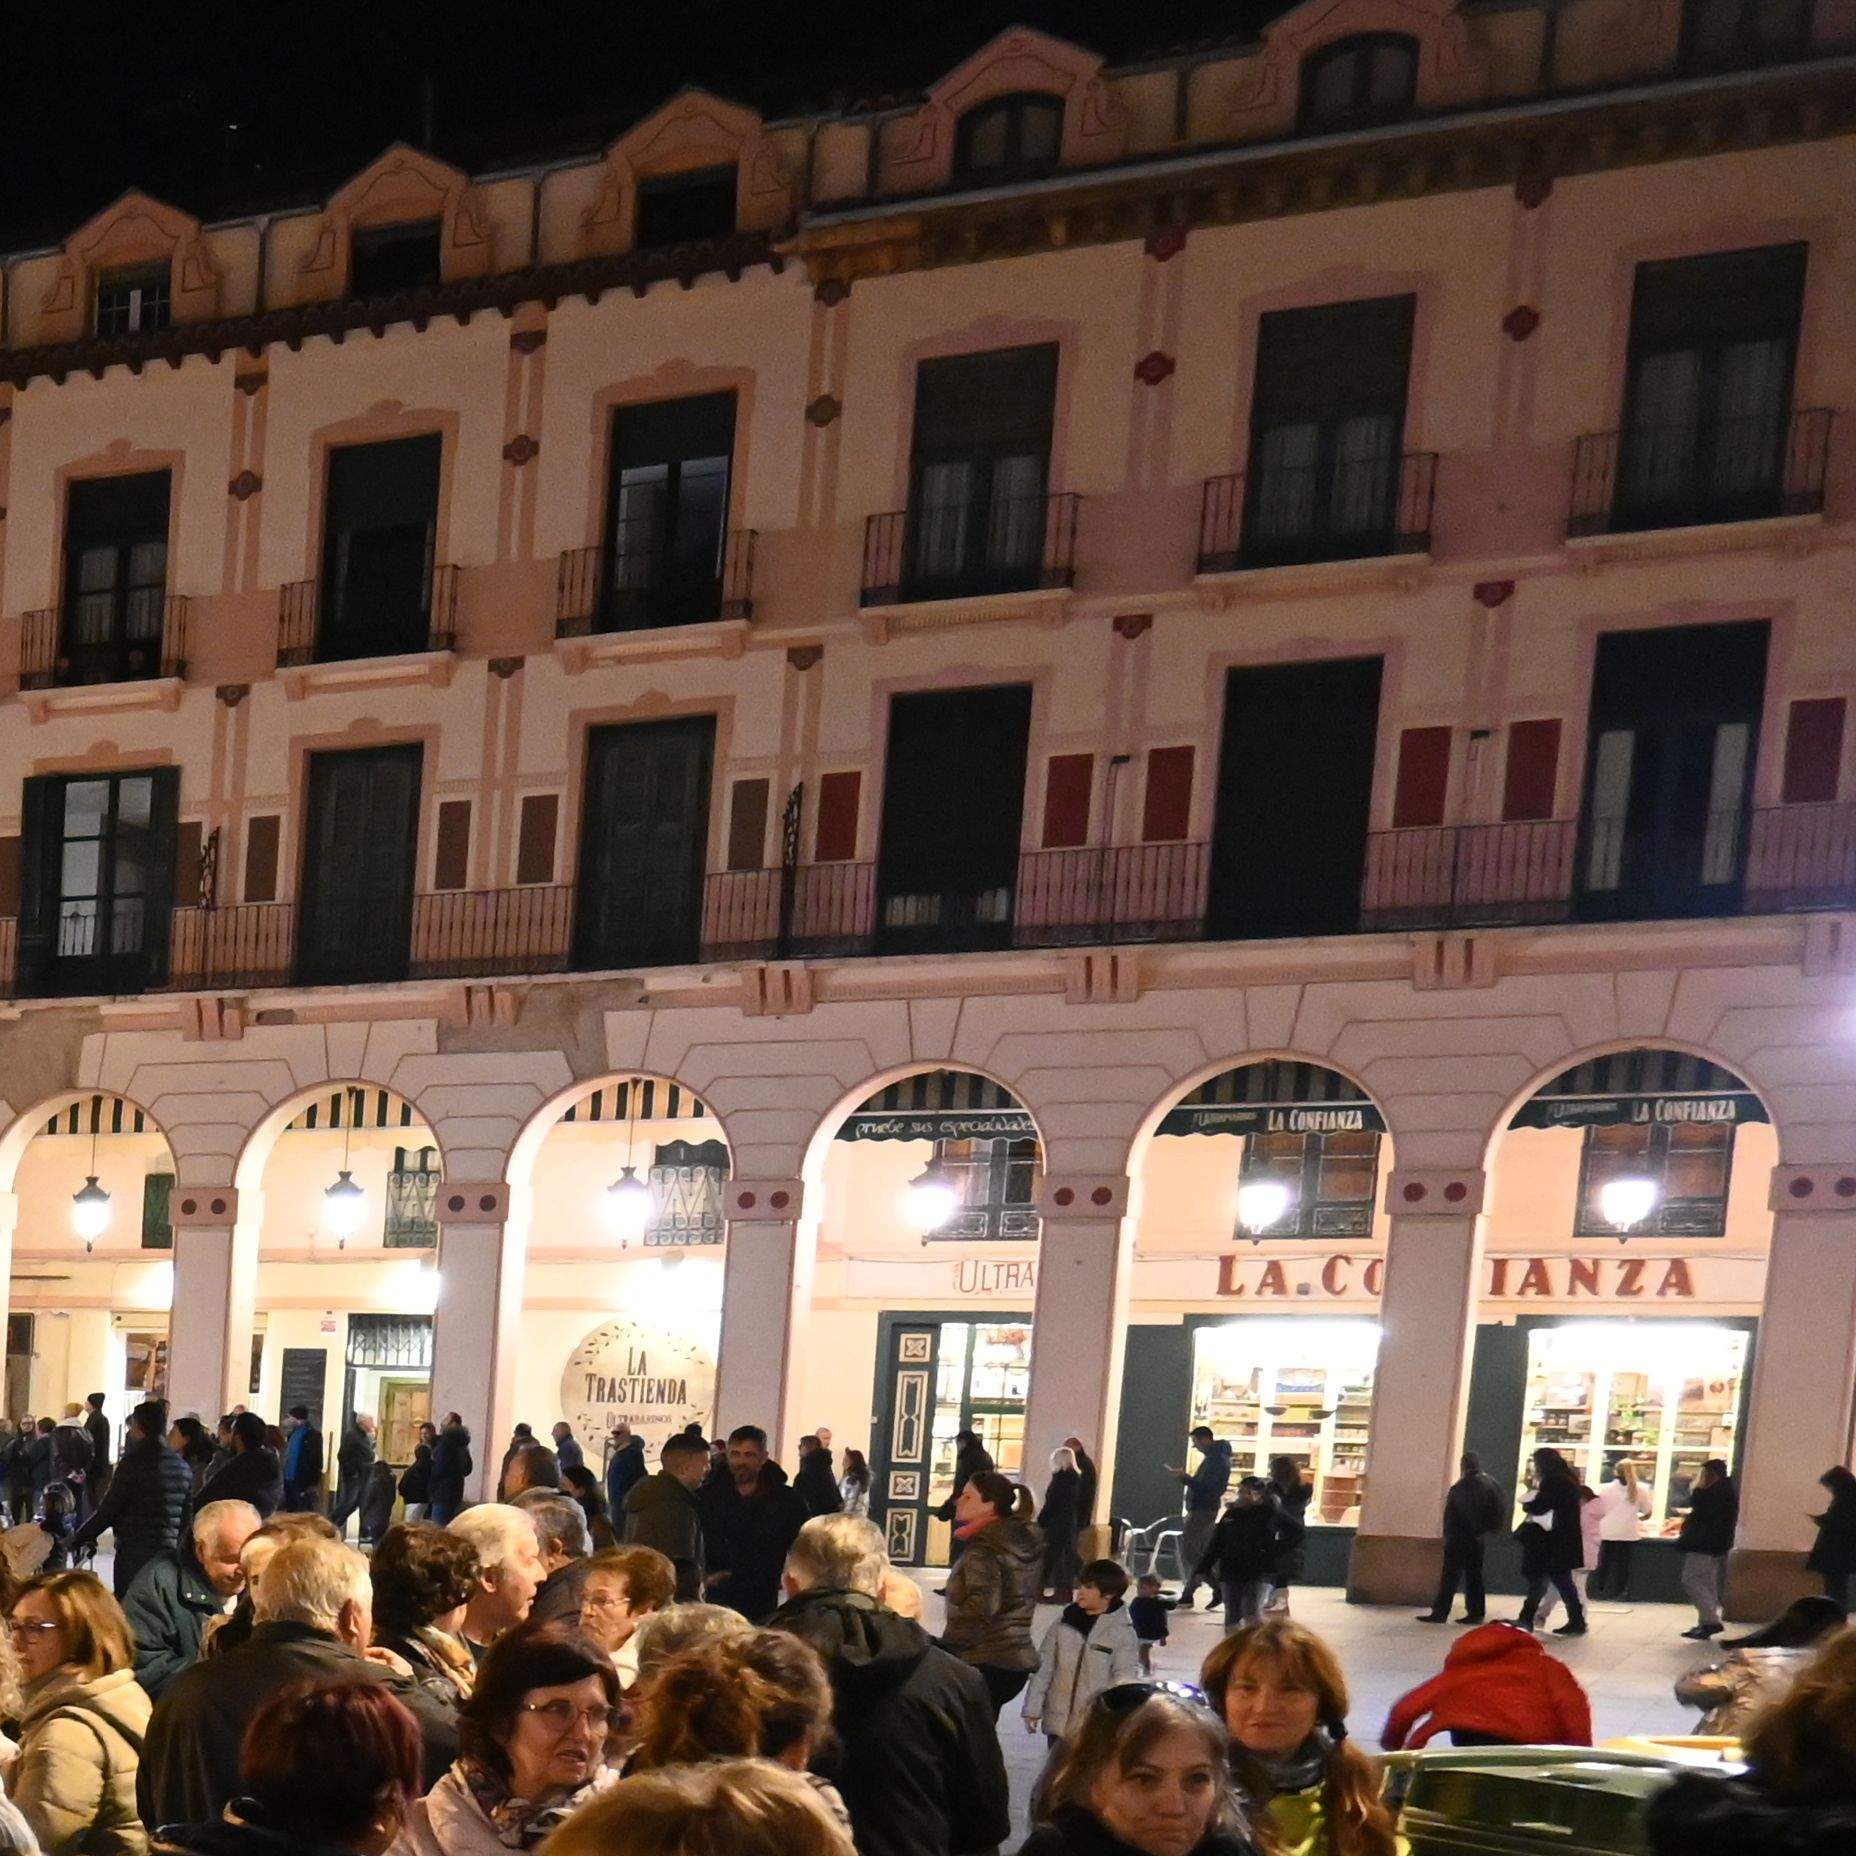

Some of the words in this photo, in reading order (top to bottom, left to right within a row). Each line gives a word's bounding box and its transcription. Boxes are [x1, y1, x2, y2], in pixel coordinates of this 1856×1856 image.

[1268, 1109, 1284, 1131] LA
[1289, 1108, 1364, 1131] CONFIANZA
[1633, 1101, 1649, 1122] LA
[1654, 1098, 1736, 1122] CONFIANZA
[855, 1118, 905, 1139] pruebe
[911, 1121, 933, 1134] sus
[939, 1115, 1037, 1138] especialidades
[1216, 1255, 1288, 1296] LA
[627, 1346, 647, 1376] LA
[585, 1373, 687, 1405] TRASTIENDA
